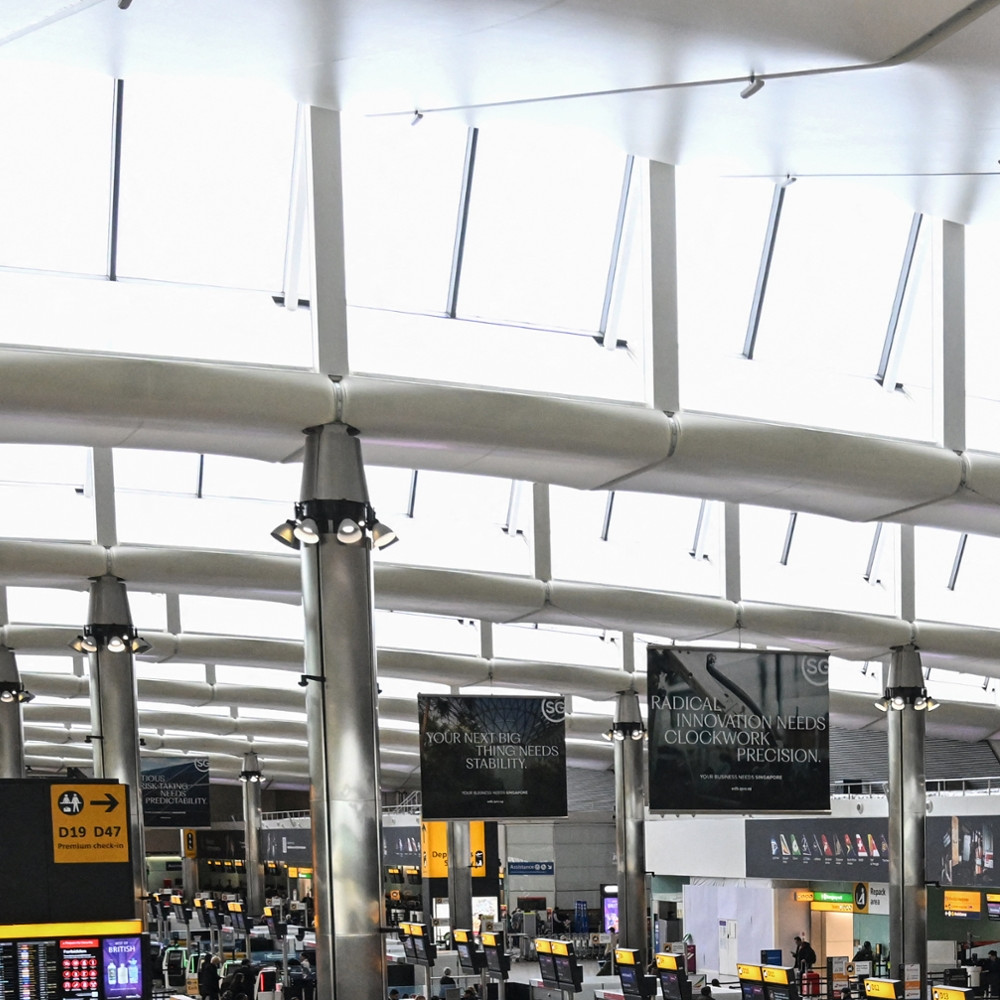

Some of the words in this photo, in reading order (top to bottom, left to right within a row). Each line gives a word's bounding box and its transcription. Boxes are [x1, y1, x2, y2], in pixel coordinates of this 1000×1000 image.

[806, 658, 829, 675] SG
[545, 701, 565, 714] SG
[651, 695, 722, 712] RADICAL
[676, 713, 772, 730] INNOVATION
[777, 716, 826, 731] NEEDS
[426, 732, 461, 744] YOUR
[464, 732, 495, 744] NEXT
[499, 732, 521, 744] BIG
[664, 730, 771, 746] CLOCKWORK
[476, 745, 516, 757] THING
[520, 745, 559, 757] NEEDS
[737, 748, 822, 763] PRECISION.
[465, 758, 528, 770] STABILITY.
[58, 826, 87, 838] D19
[94, 826, 122, 838] D47
[93, 842, 124, 850] check-in
[870, 887, 886, 897] Repack
[108, 945, 136, 953] BRITISH
